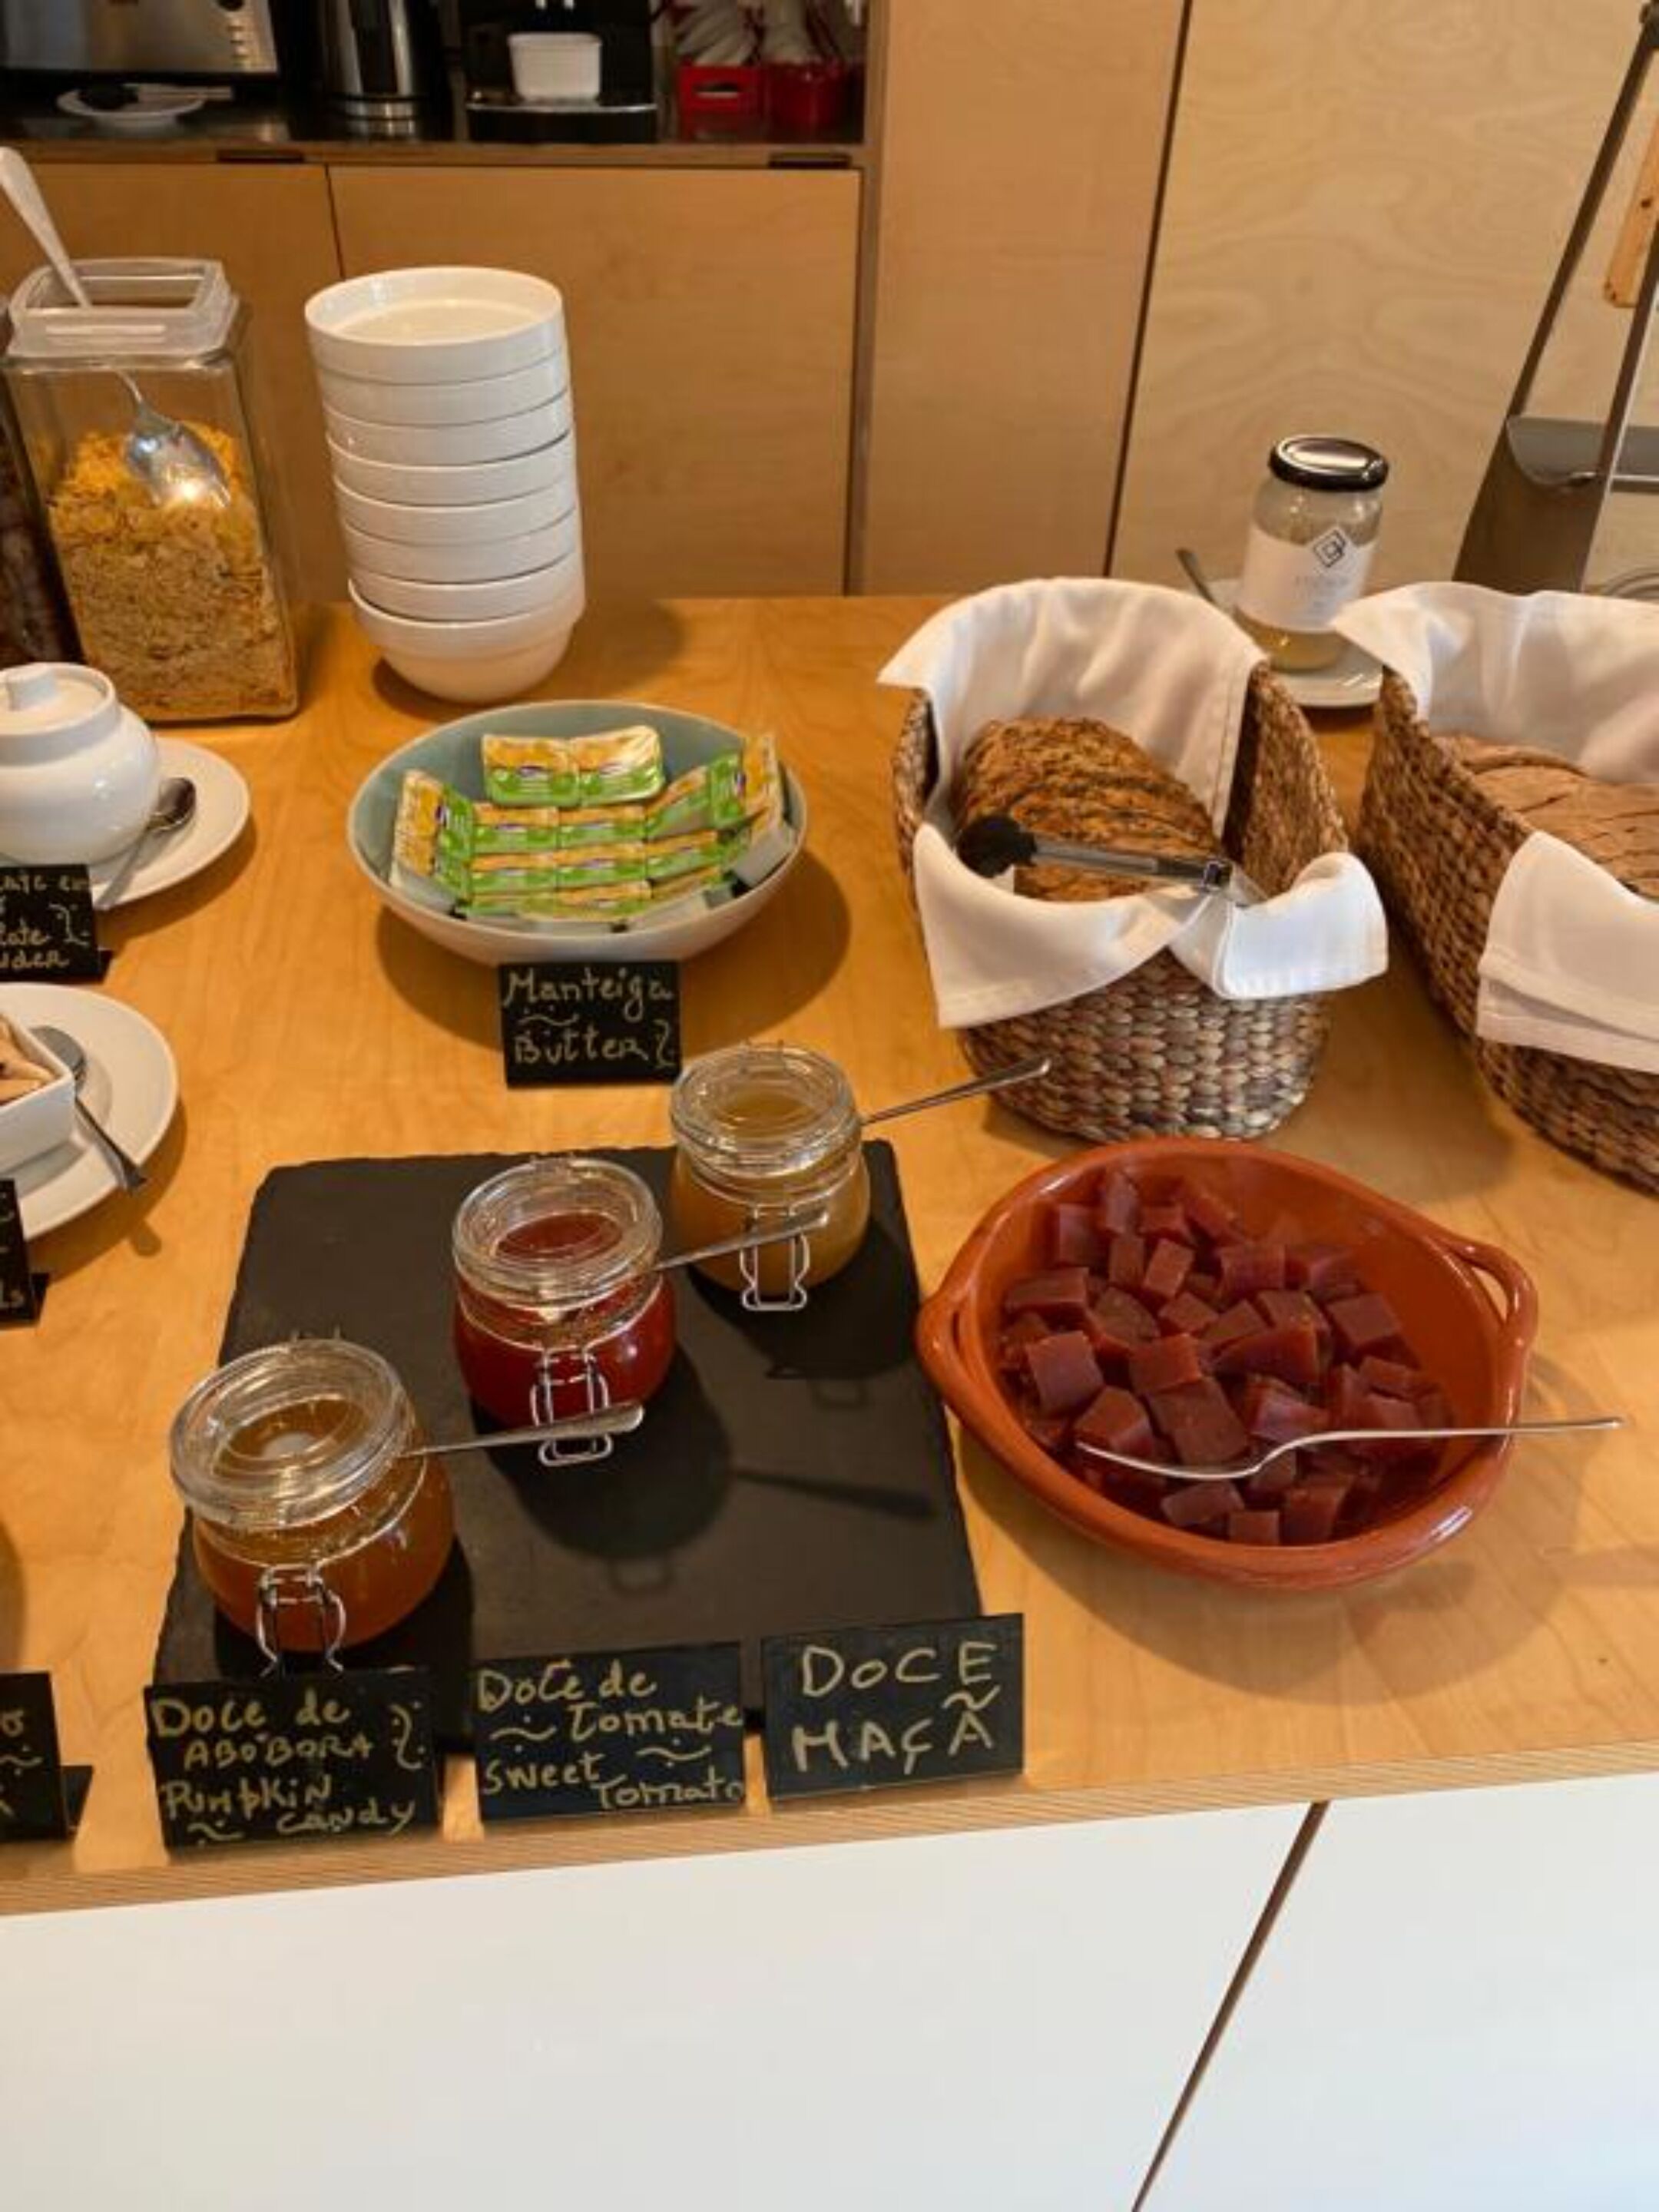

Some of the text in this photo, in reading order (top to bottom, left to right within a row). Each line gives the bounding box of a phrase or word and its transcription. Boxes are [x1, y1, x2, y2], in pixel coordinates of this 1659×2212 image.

[502, 966, 674, 1022] Manteiga
[598, 1658, 657, 1697] de
[295, 1689, 353, 1727] de
